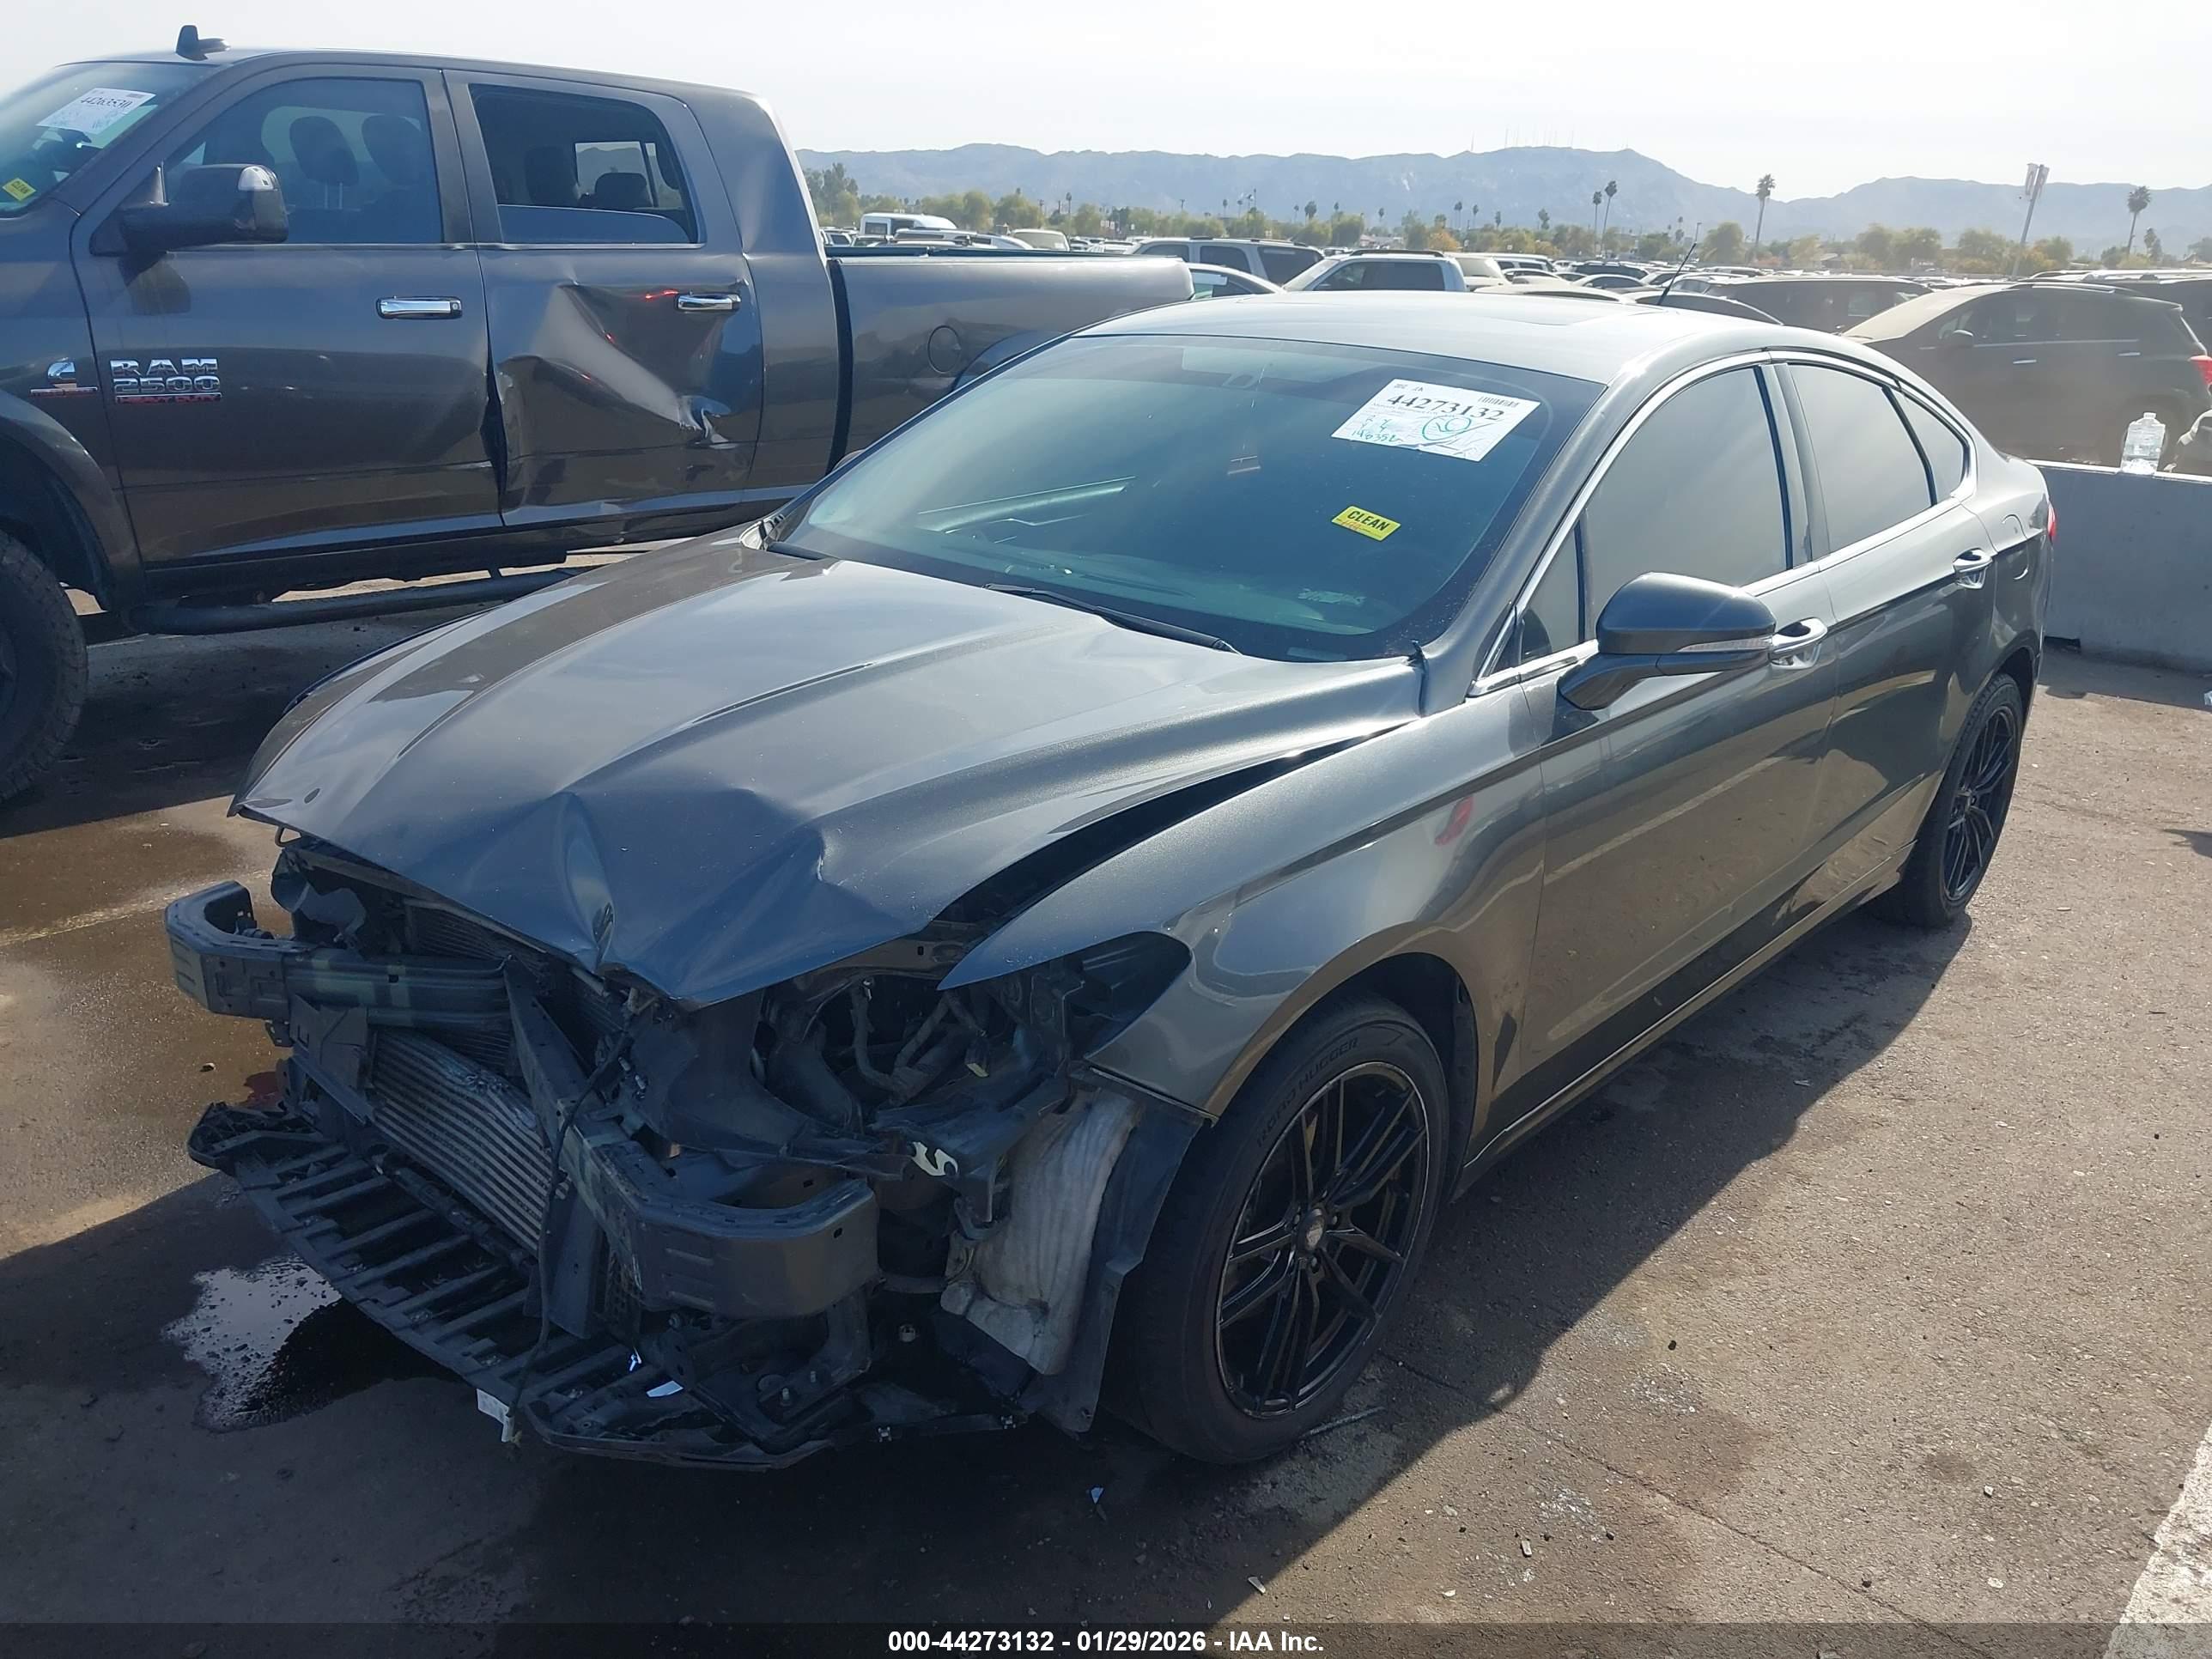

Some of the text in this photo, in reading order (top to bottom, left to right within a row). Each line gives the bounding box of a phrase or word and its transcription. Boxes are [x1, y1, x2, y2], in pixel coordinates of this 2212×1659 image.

[110, 358, 219, 375] RAM
[112, 376, 221, 393] 2500
[1388, 394, 1505, 421] 44273132
[1346, 510, 1390, 532] CLEAN
